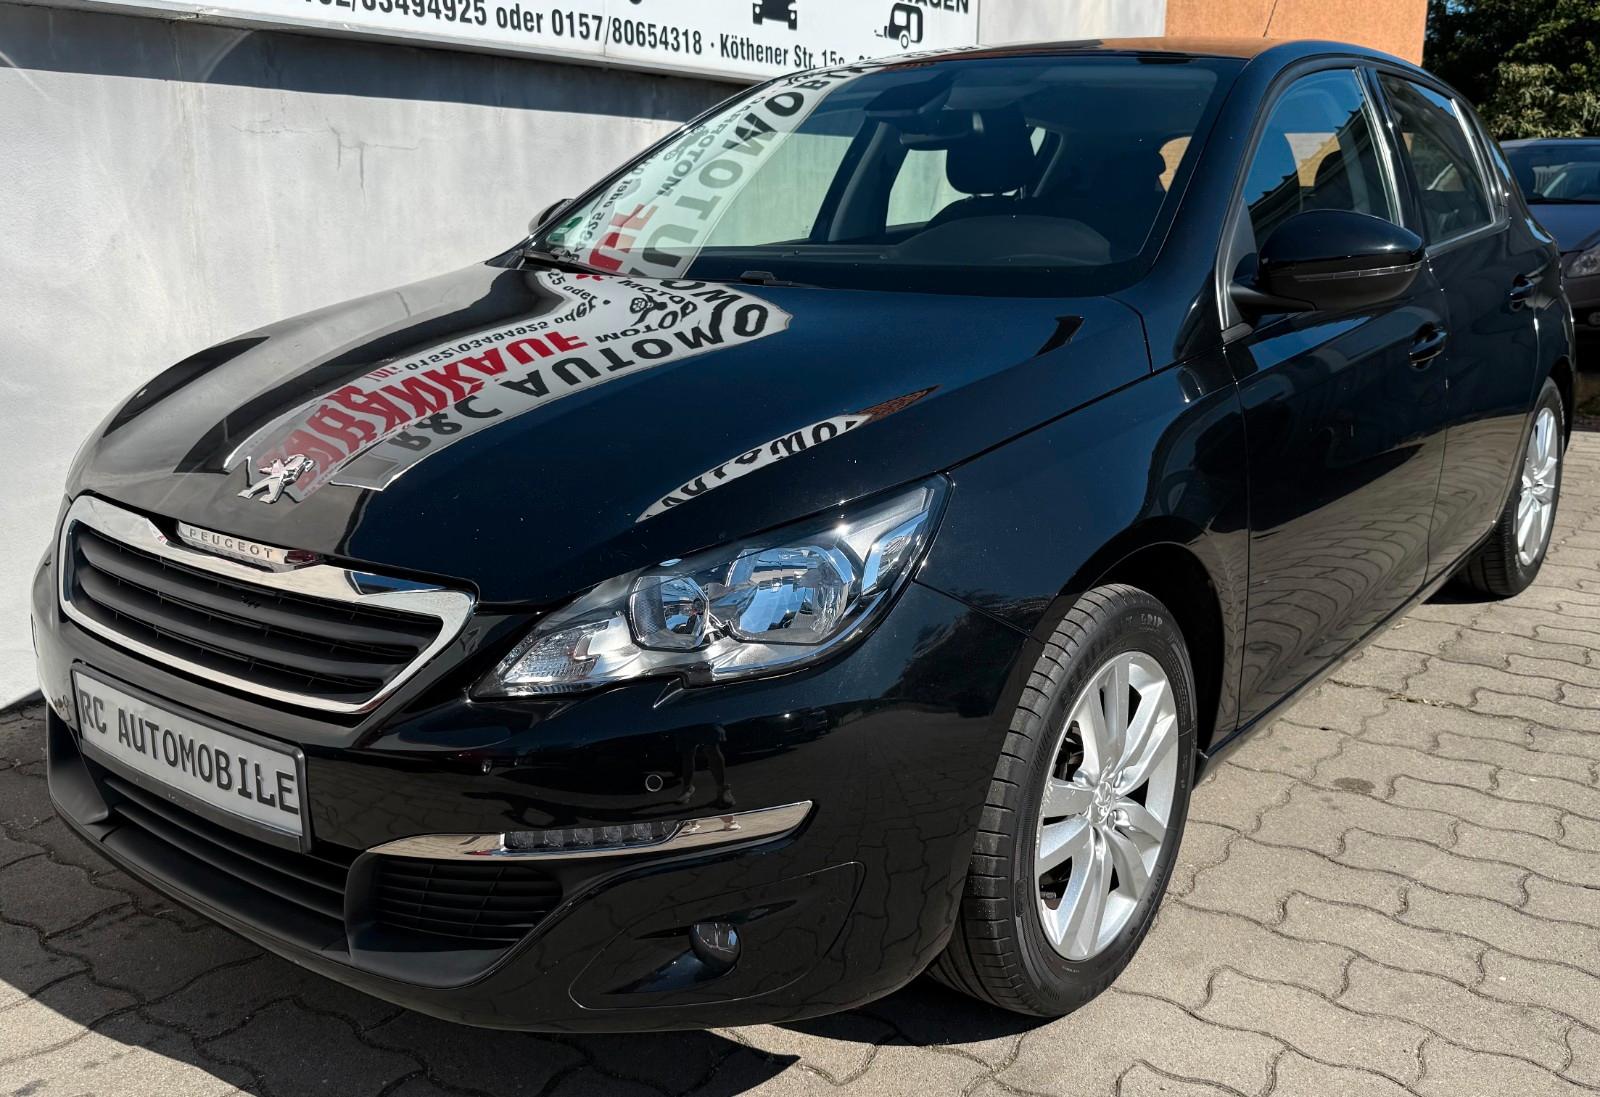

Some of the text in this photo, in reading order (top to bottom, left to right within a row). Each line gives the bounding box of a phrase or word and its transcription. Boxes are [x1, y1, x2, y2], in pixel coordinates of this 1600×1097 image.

[495, 3, 543, 33] oder
[552, 8, 702, 55] 0157/80654318
[720, 33, 789, 66] Köthener
[189, 528, 273, 559] PEUGEOT
[79, 689, 299, 815] RC AUTOMOBILE
